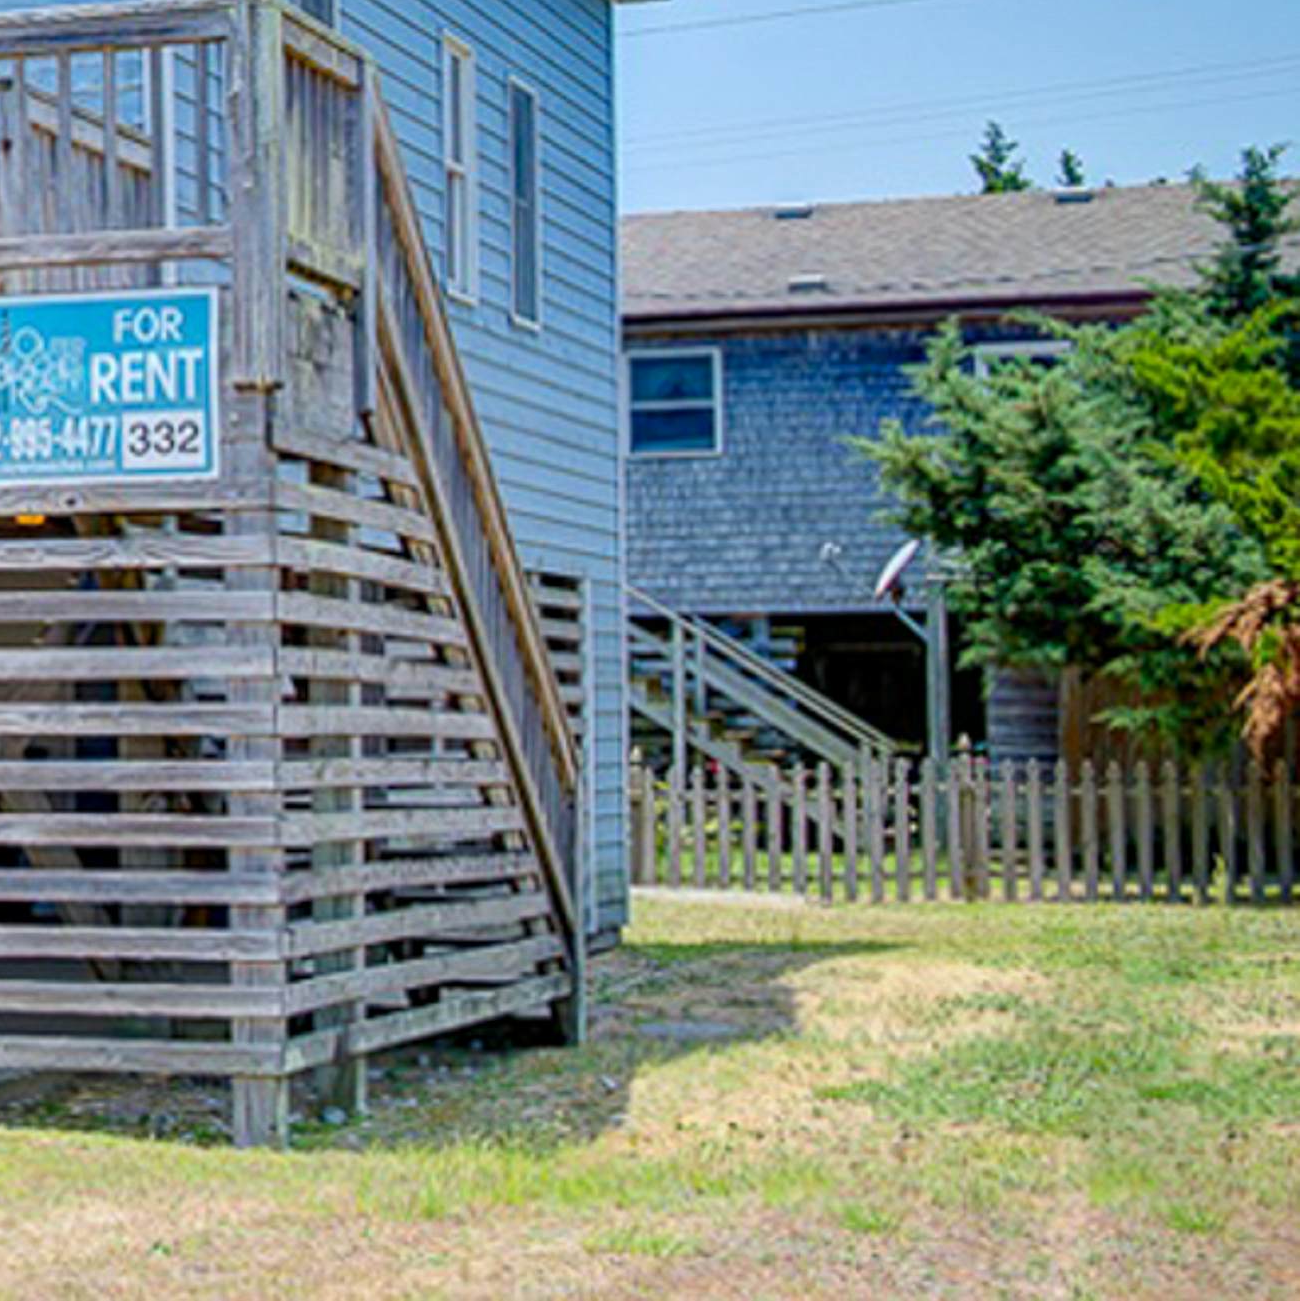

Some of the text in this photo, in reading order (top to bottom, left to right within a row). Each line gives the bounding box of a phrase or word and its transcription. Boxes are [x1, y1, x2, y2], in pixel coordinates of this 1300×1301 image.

[113, 306, 183, 343] FOR
[90, 347, 203, 404] RENT
[128, 420, 199, 456] 332
